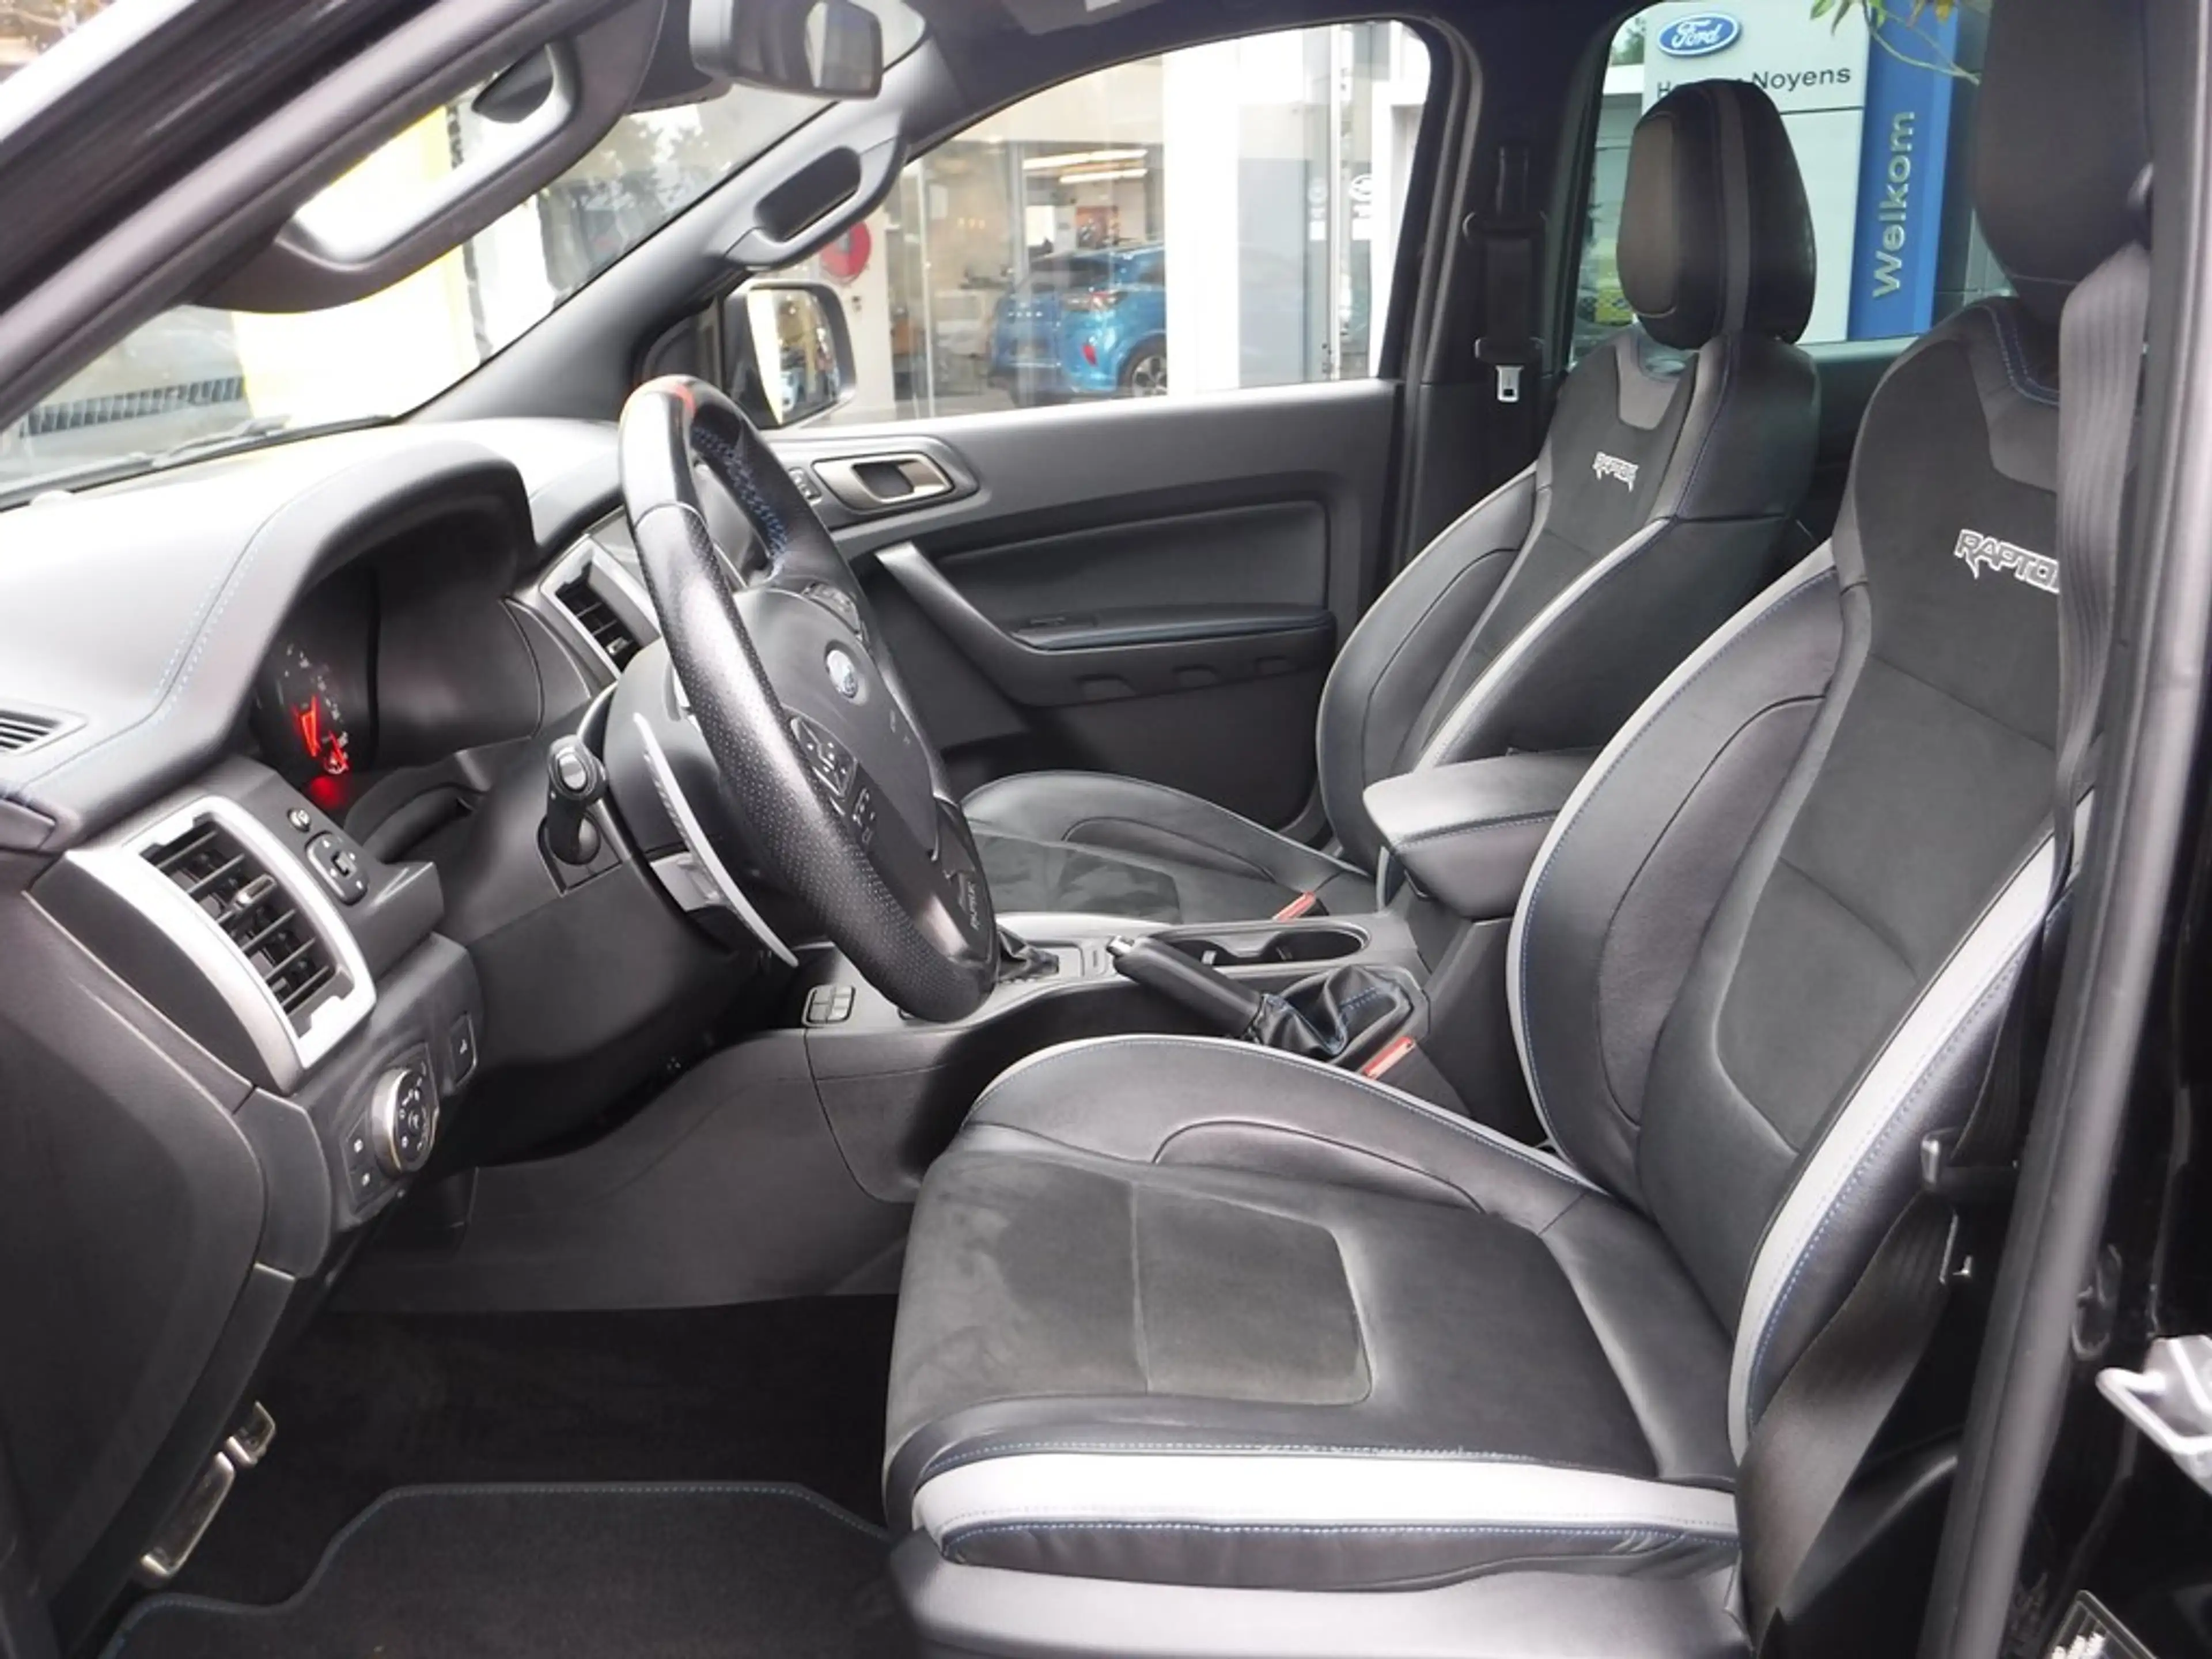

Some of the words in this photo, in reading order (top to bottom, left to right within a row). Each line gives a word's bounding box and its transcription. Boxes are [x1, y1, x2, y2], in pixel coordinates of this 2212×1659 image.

[1671, 19, 1723, 48] Ford
[1752, 67, 1851, 93] Noyens
[1872, 111, 1915, 298] Welkom
[1953, 528, 2060, 594] RAPTO
